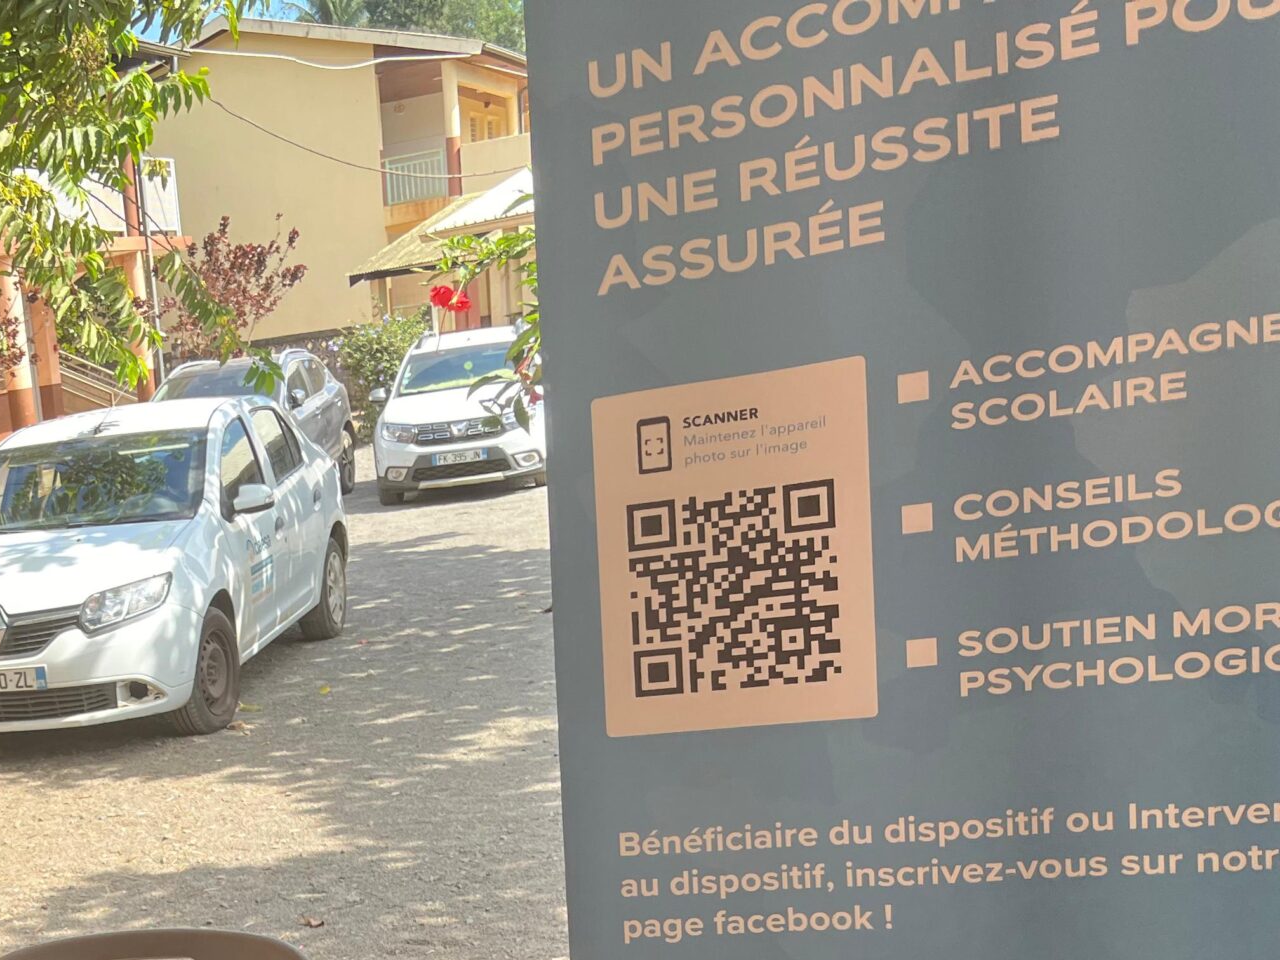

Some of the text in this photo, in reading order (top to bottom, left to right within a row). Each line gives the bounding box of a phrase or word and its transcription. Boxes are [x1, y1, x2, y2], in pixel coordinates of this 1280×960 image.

[589, 0, 996, 97] UN ACCOM
[592, 1, 1099, 165] PERSONNALISÉ
[595, 95, 1059, 228] UNE RÉUSSITE
[599, 199, 884, 294] ASSURÉE
[951, 314, 1280, 388] ACCOMPAGNE
[683, 408, 759, 429] SCANNER
[952, 372, 1186, 429] SCOLAIRE
[683, 415, 826, 447] Maintenez l'appareil
[684, 440, 808, 468] photo sur l'image
[955, 469, 1181, 520] CONSEILS
[959, 614, 1155, 656] SOUTIEN
[620, 823, 817, 857] Bénéficiaire
[829, 820, 872, 846] du
[885, 808, 1053, 847] dispositif
[1067, 810, 1113, 833] ou
[621, 845, 1279, 898] au dispositif, inscrivez-vous sur notr
[624, 904, 893, 944] page facebook !
